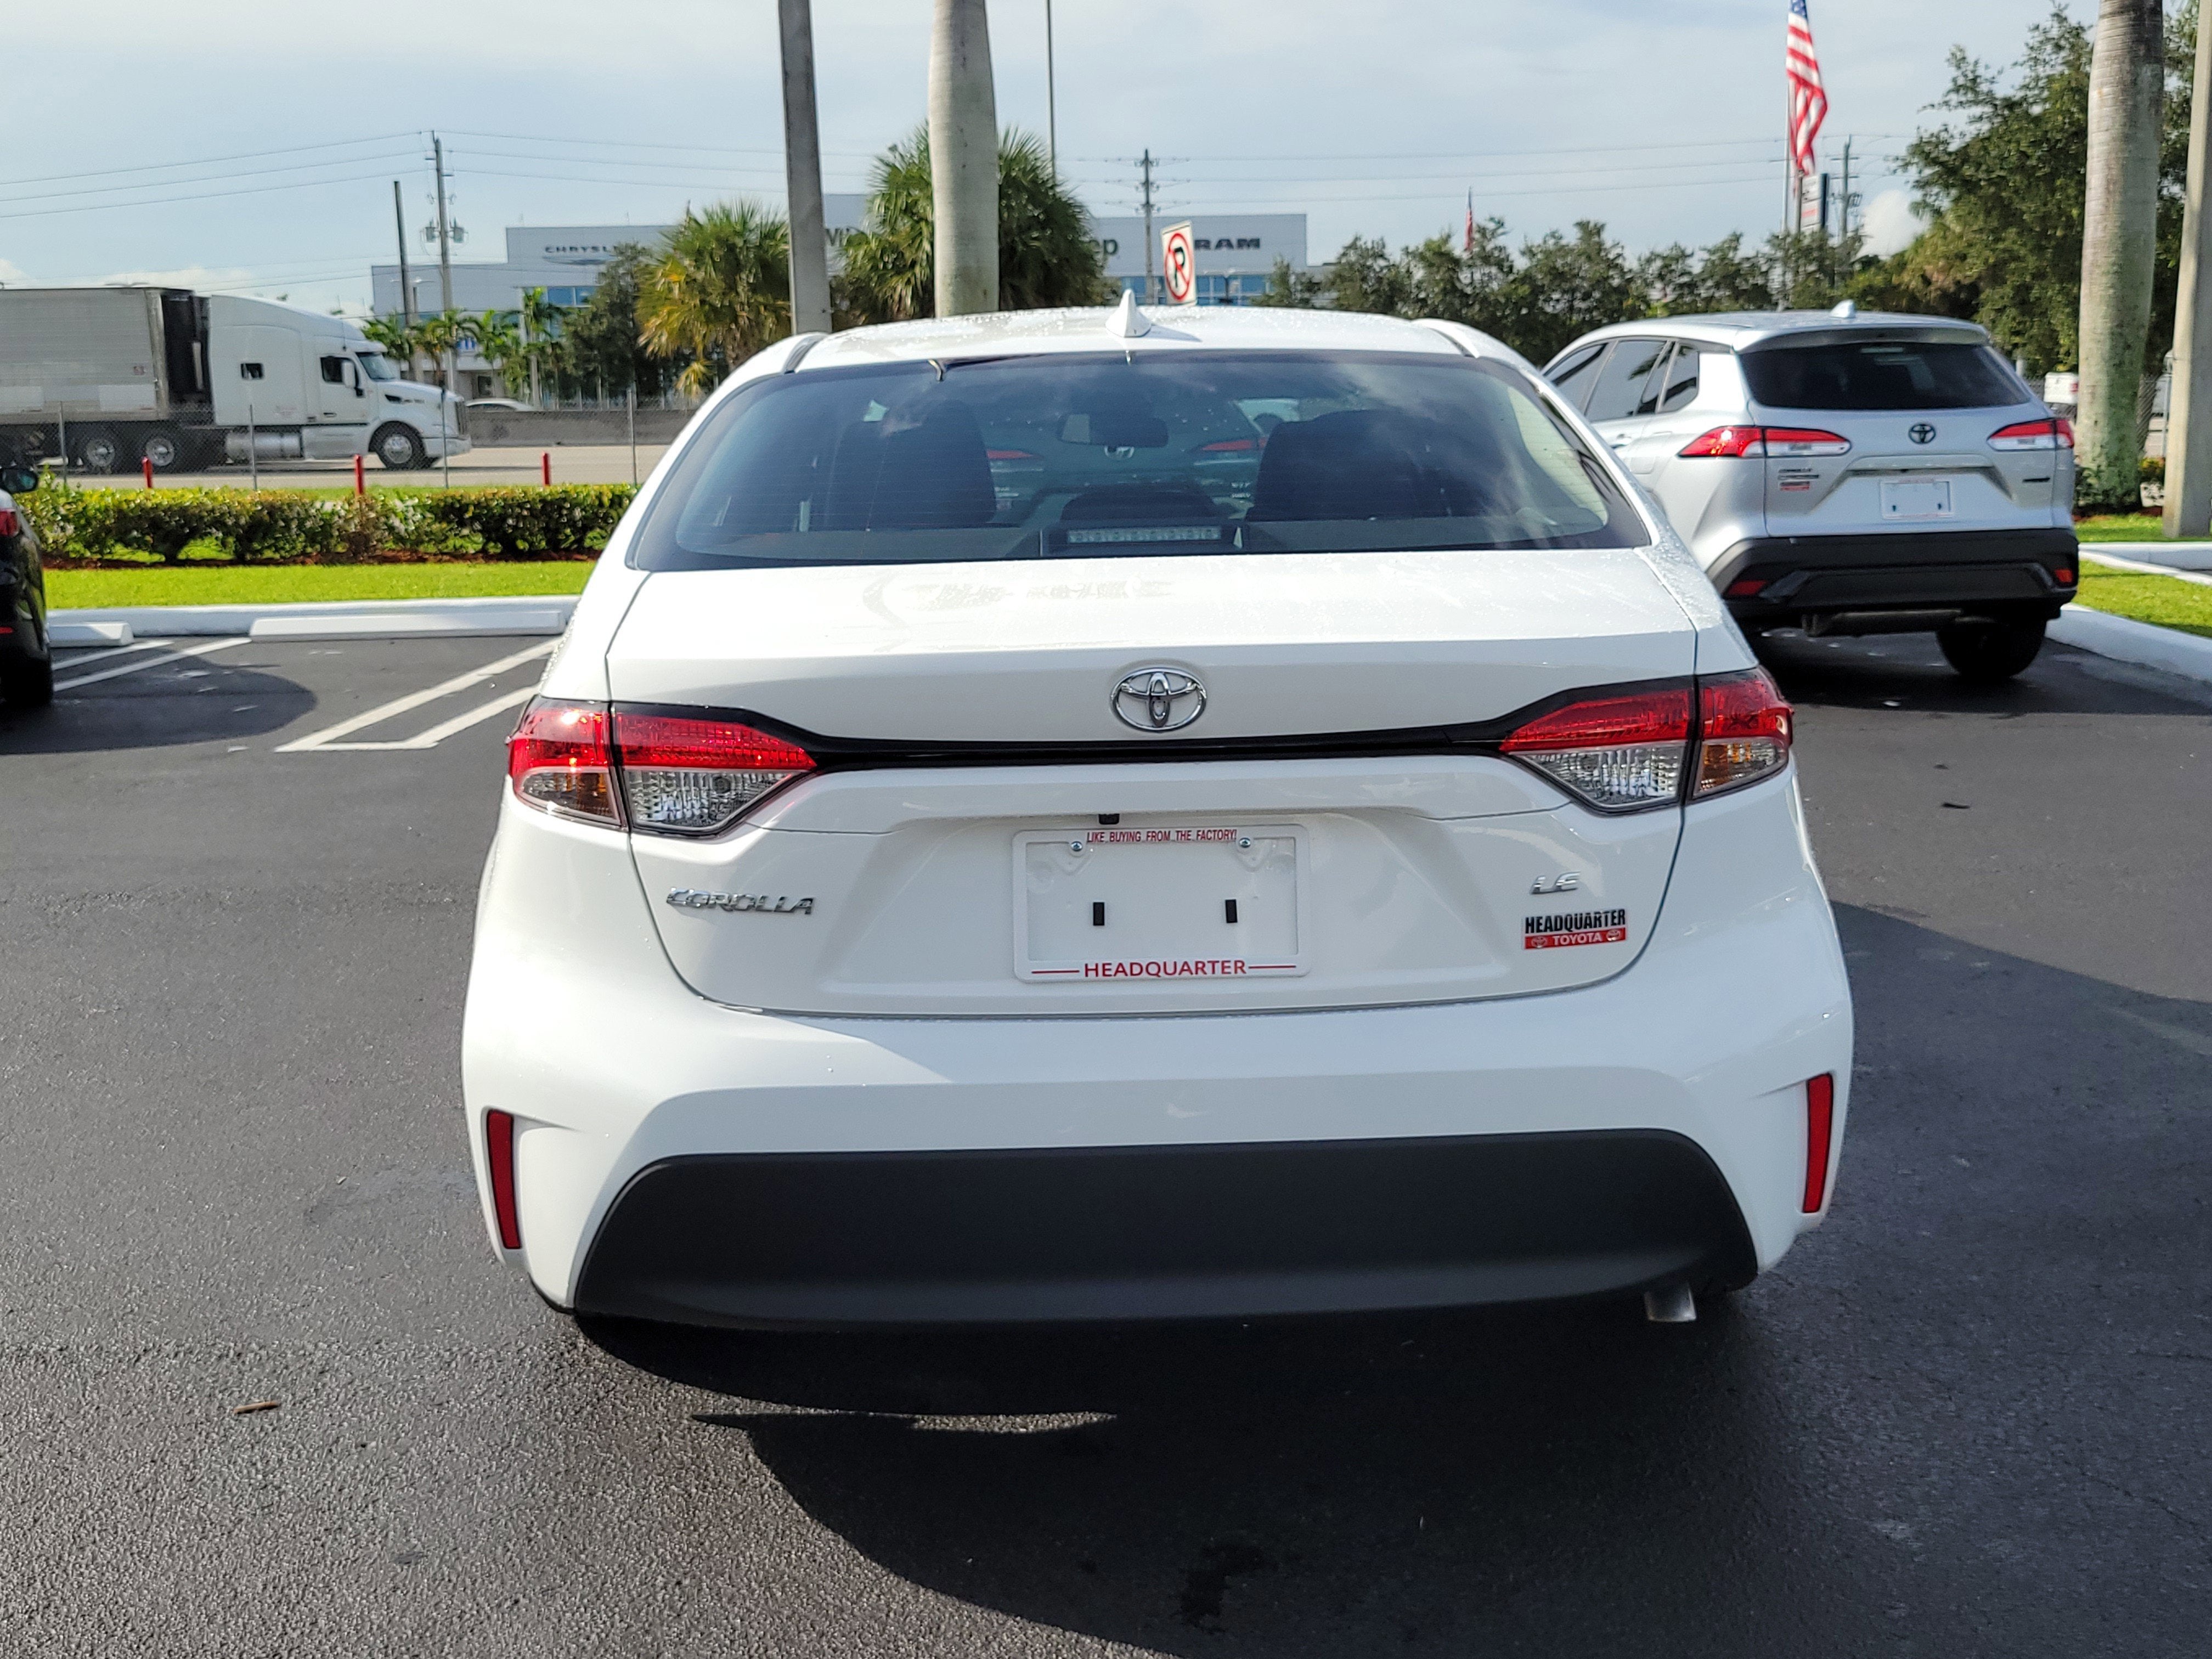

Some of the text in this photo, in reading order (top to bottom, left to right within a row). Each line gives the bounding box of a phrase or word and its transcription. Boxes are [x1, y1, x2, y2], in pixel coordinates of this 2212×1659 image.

[1194, 238, 1260, 250] RAM
[1087, 829, 1238, 843] LIKE BUYING FROM THE FACTORY!
[1530, 871, 1581, 895] LE
[666, 887, 815, 915] COROLLA
[1525, 909, 1626, 934] HEADQUARTER
[1552, 932, 1603, 946] TOYOTA
[1084, 960, 1247, 978] HEADQUARTER
